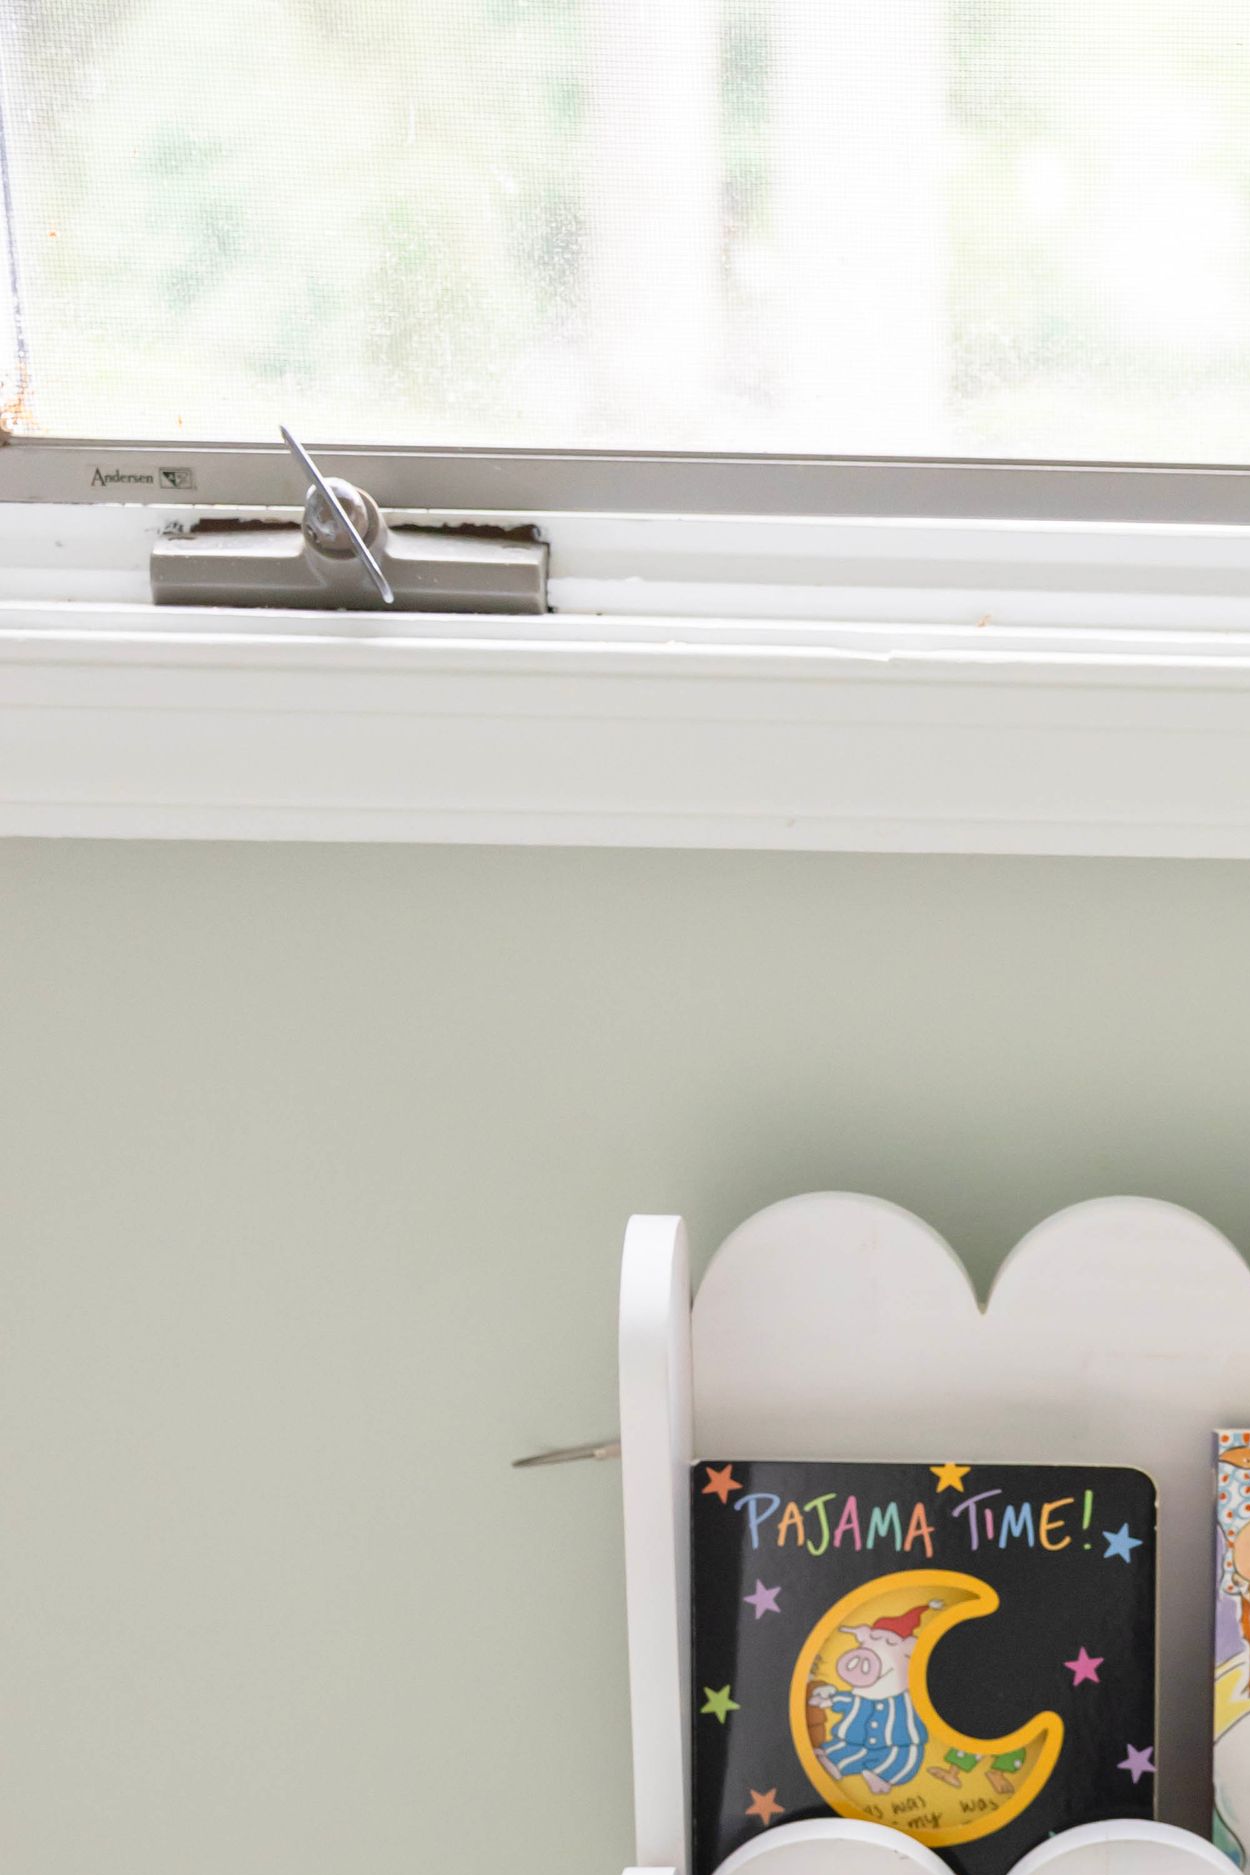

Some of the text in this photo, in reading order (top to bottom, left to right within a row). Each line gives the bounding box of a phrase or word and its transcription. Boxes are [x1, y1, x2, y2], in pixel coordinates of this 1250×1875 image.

[91, 466, 154, 487] Andersen
[733, 1488, 1093, 1558] PAJAMA TIME!
